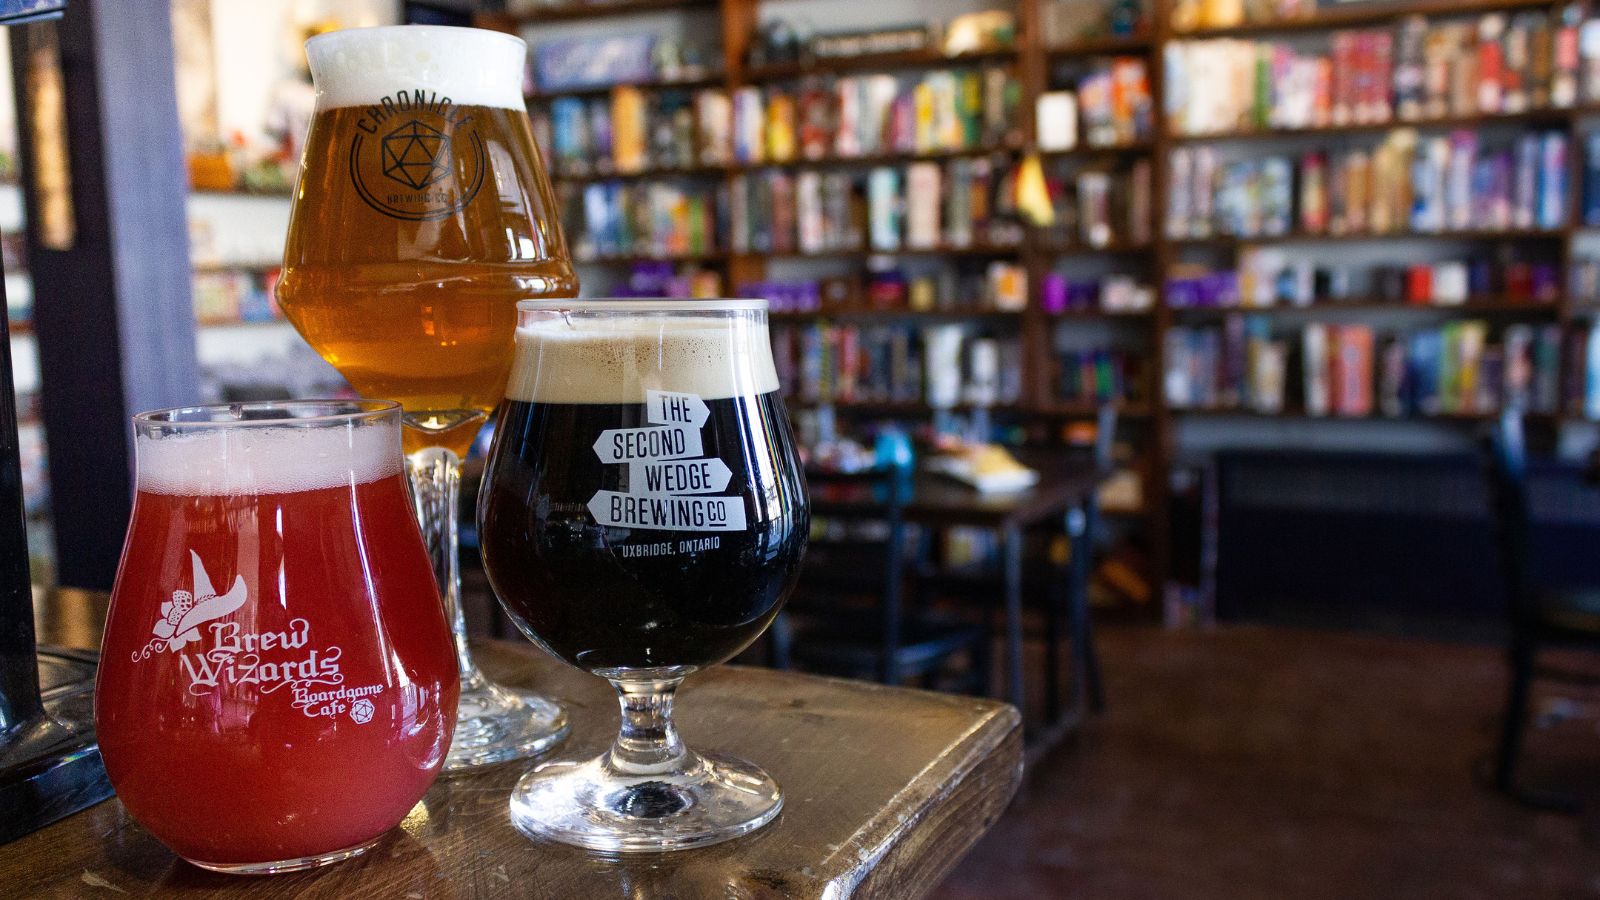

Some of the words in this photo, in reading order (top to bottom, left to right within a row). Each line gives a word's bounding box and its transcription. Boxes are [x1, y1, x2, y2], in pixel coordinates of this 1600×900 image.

[659, 394, 692, 423] THE
[613, 428, 686, 460] SECOND
[645, 463, 712, 492] WEDGE
[610, 495, 705, 527] BREWING
[707, 501, 727, 524] CO
[622, 542, 676, 558] UXBRIDGE,
[679, 536, 720, 554] ONTARIO
[208, 618, 310, 655] Brew
[180, 647, 344, 694] Wizards
[291, 684, 384, 707] Boardgame
[303, 700, 346, 719] Cafe
